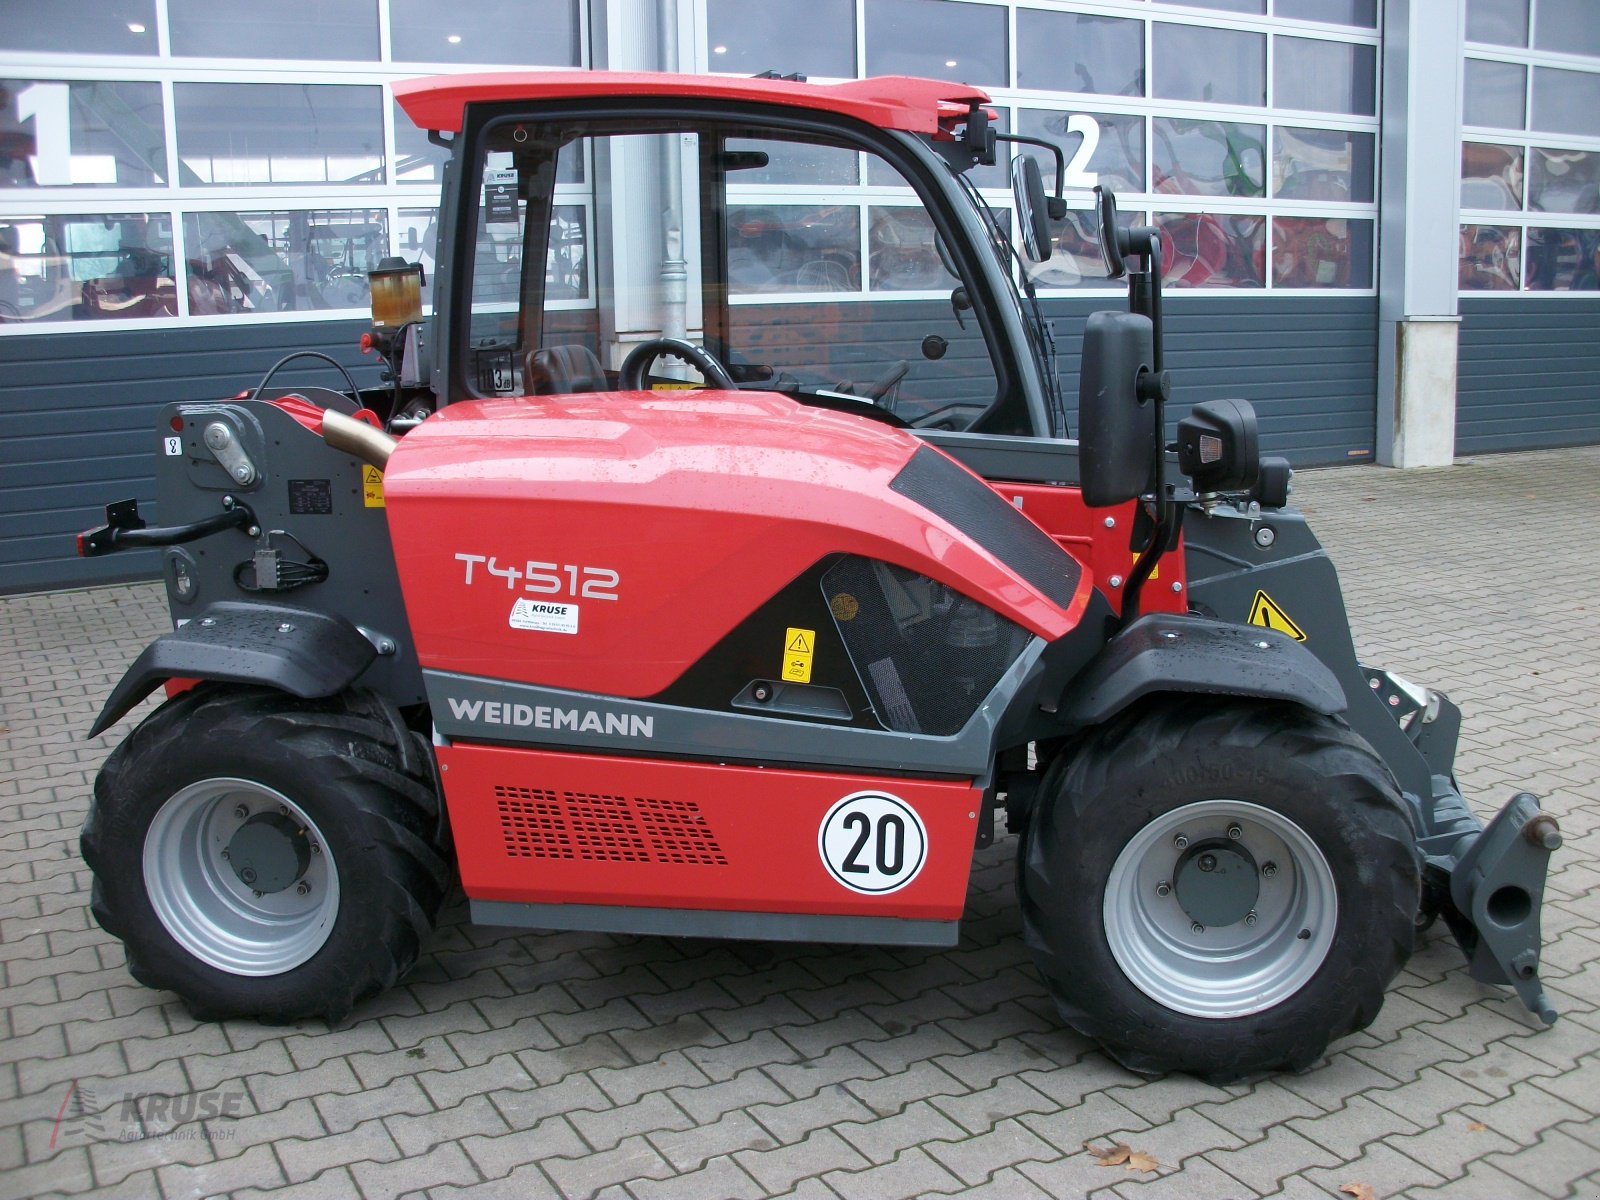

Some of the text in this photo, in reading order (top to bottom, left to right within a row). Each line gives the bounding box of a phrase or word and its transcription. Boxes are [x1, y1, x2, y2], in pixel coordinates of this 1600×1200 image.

[17, 83, 72, 186] 1
[1063, 114, 1100, 188] 2
[455, 553, 620, 601] T4512
[532, 604, 568, 615] KRUSE
[448, 698, 654, 738] WEIDEMANN
[842, 811, 905, 876] 20
